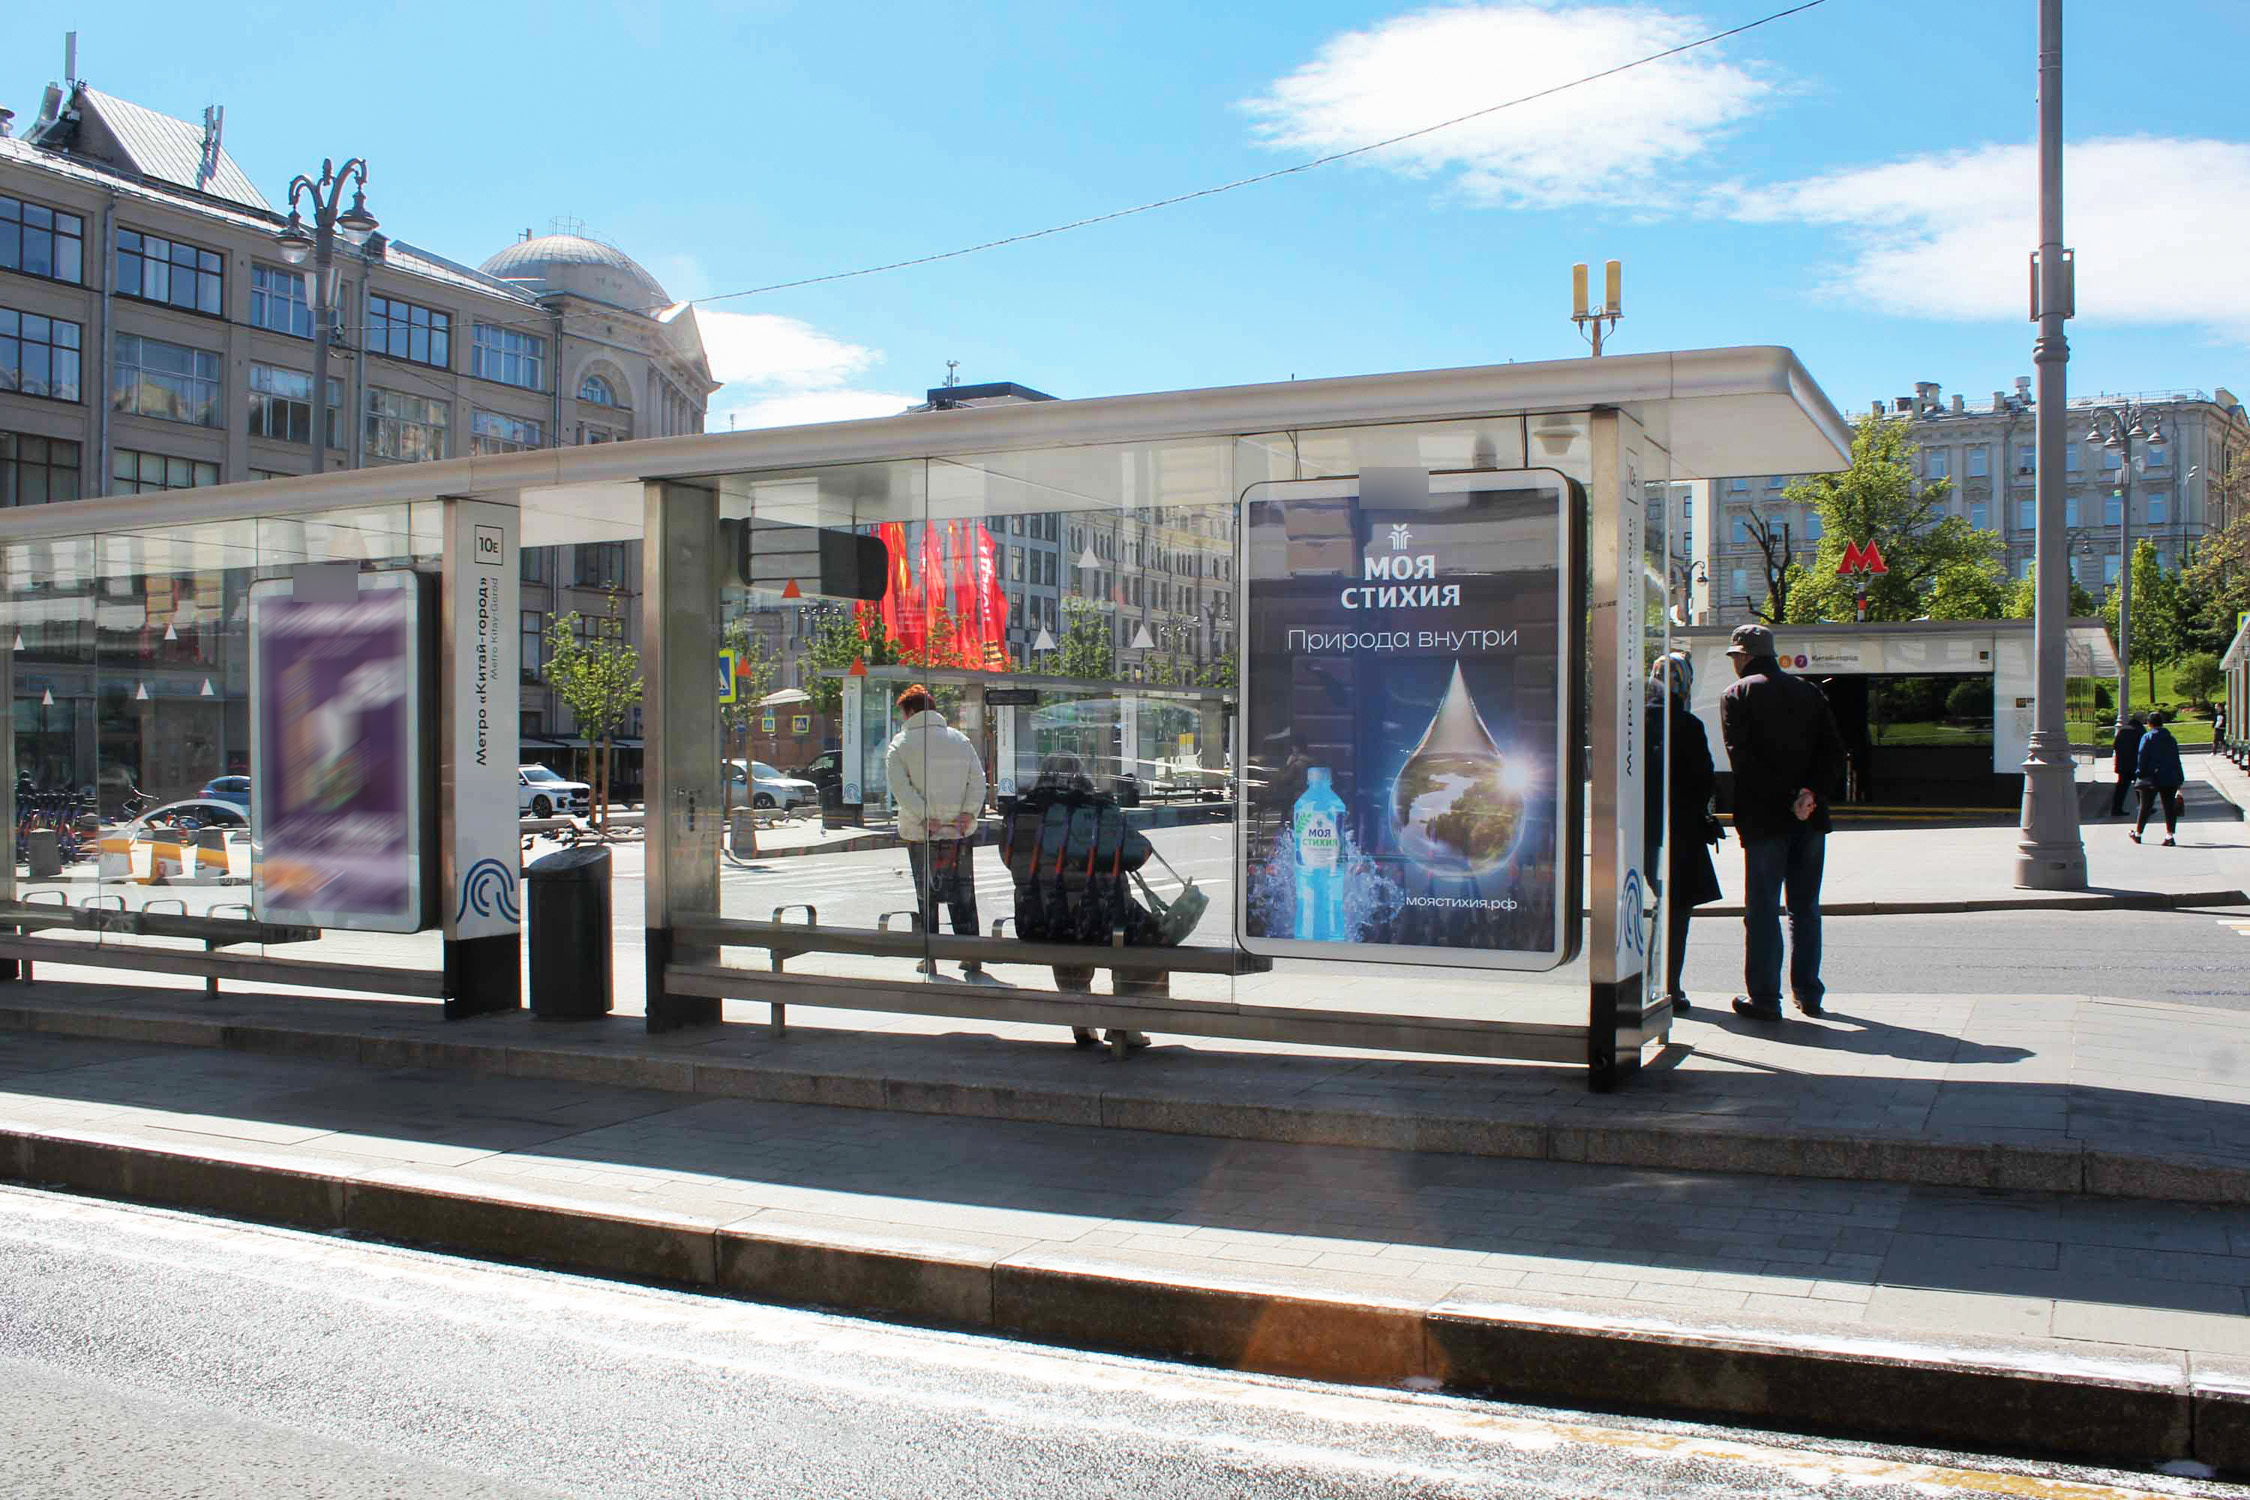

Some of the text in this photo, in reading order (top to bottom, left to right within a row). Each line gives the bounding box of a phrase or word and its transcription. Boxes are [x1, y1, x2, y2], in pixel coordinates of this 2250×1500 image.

[1364, 554, 1436, 581] МОЯ
[1341, 584, 1461, 609] СТИХИЯ
[1288, 629, 1518, 653] Природа внутри
[475, 577, 488, 766] Метро «Китай-город»
[490, 647, 499, 680] Metro
[1302, 838, 1338, 847] СТИХИЯ
[1308, 828, 1331, 838] МОЯ
[1406, 896, 1518, 912] моястихия.рф
